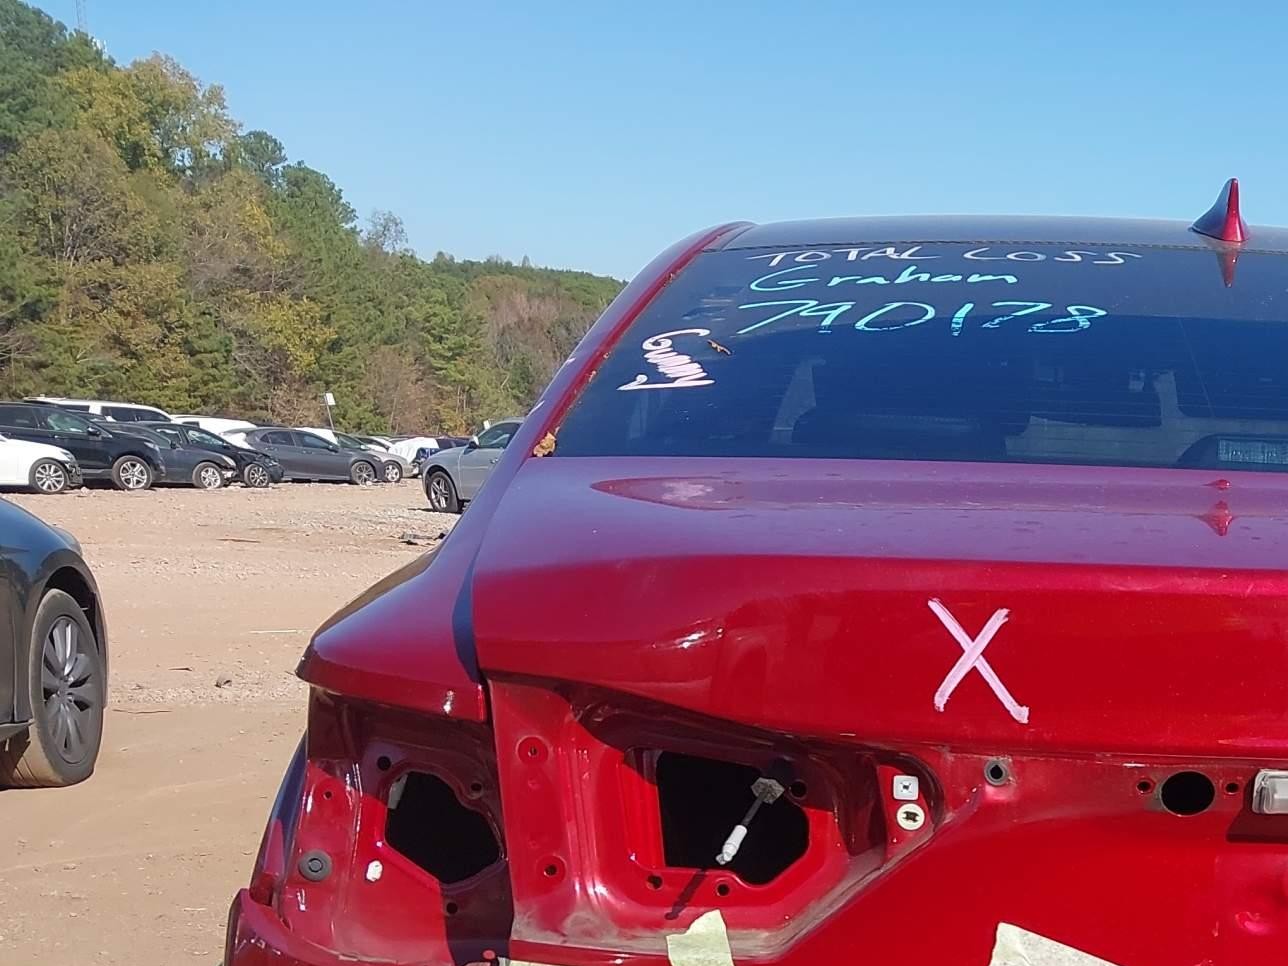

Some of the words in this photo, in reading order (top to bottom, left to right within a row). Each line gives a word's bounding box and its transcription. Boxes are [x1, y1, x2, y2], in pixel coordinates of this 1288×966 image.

[745, 246, 939, 267] TOTAL
[963, 247, 1142, 265] LOSS
[750, 264, 1018, 292] Graham
[736, 299, 1107, 337] 790178
